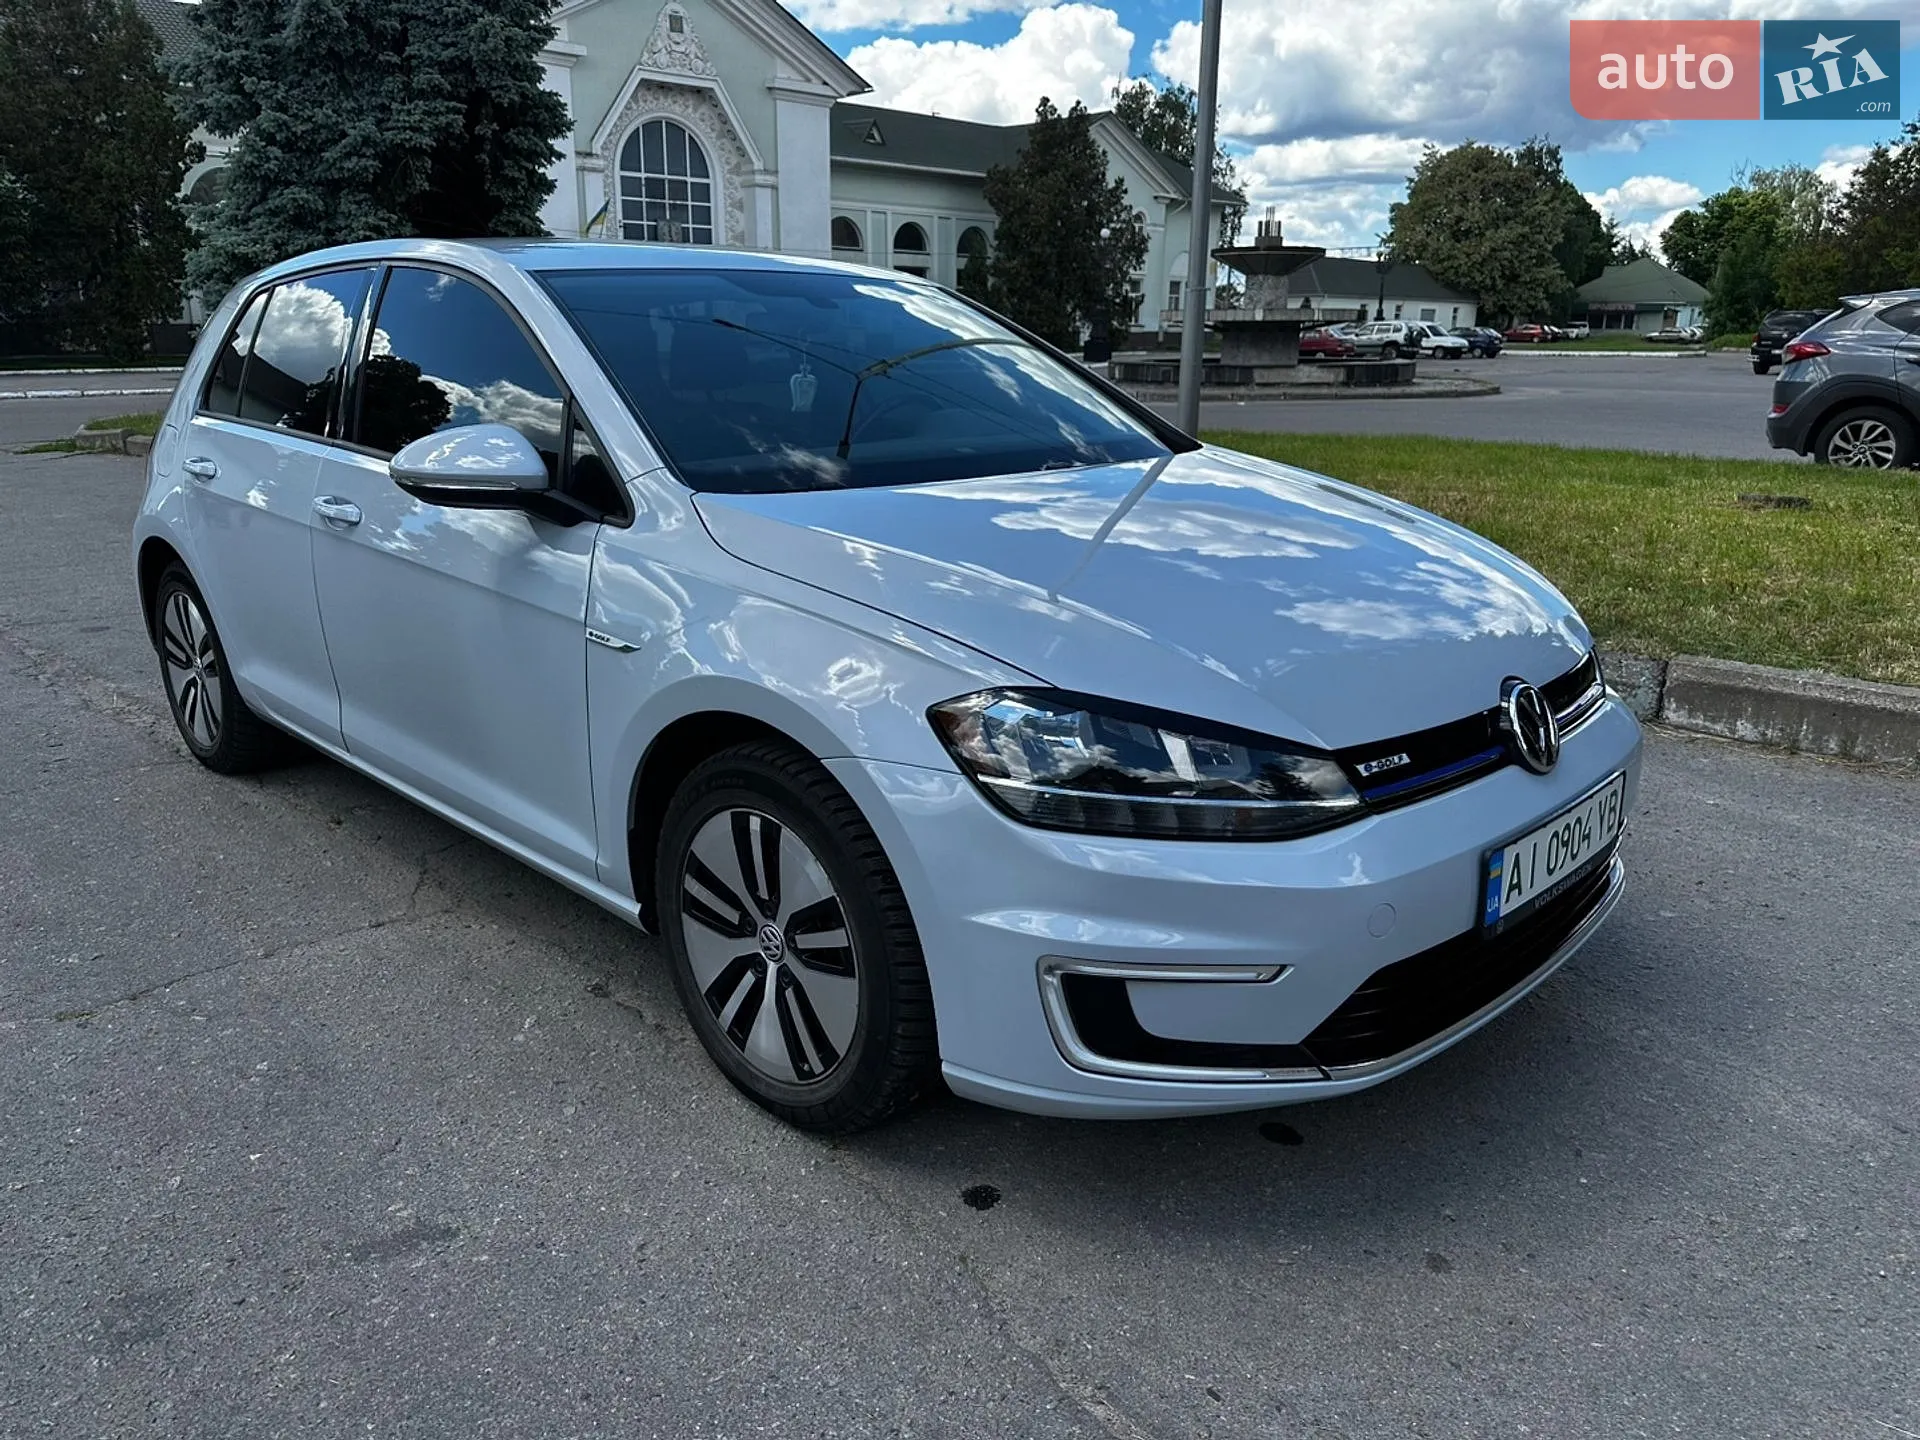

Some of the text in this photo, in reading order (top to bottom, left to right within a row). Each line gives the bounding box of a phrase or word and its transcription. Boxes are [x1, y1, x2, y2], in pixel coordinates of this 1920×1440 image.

[1504, 842, 1537, 904] AI
[1546, 807, 1592, 877] 0904
[1487, 896, 1499, 912] UA
